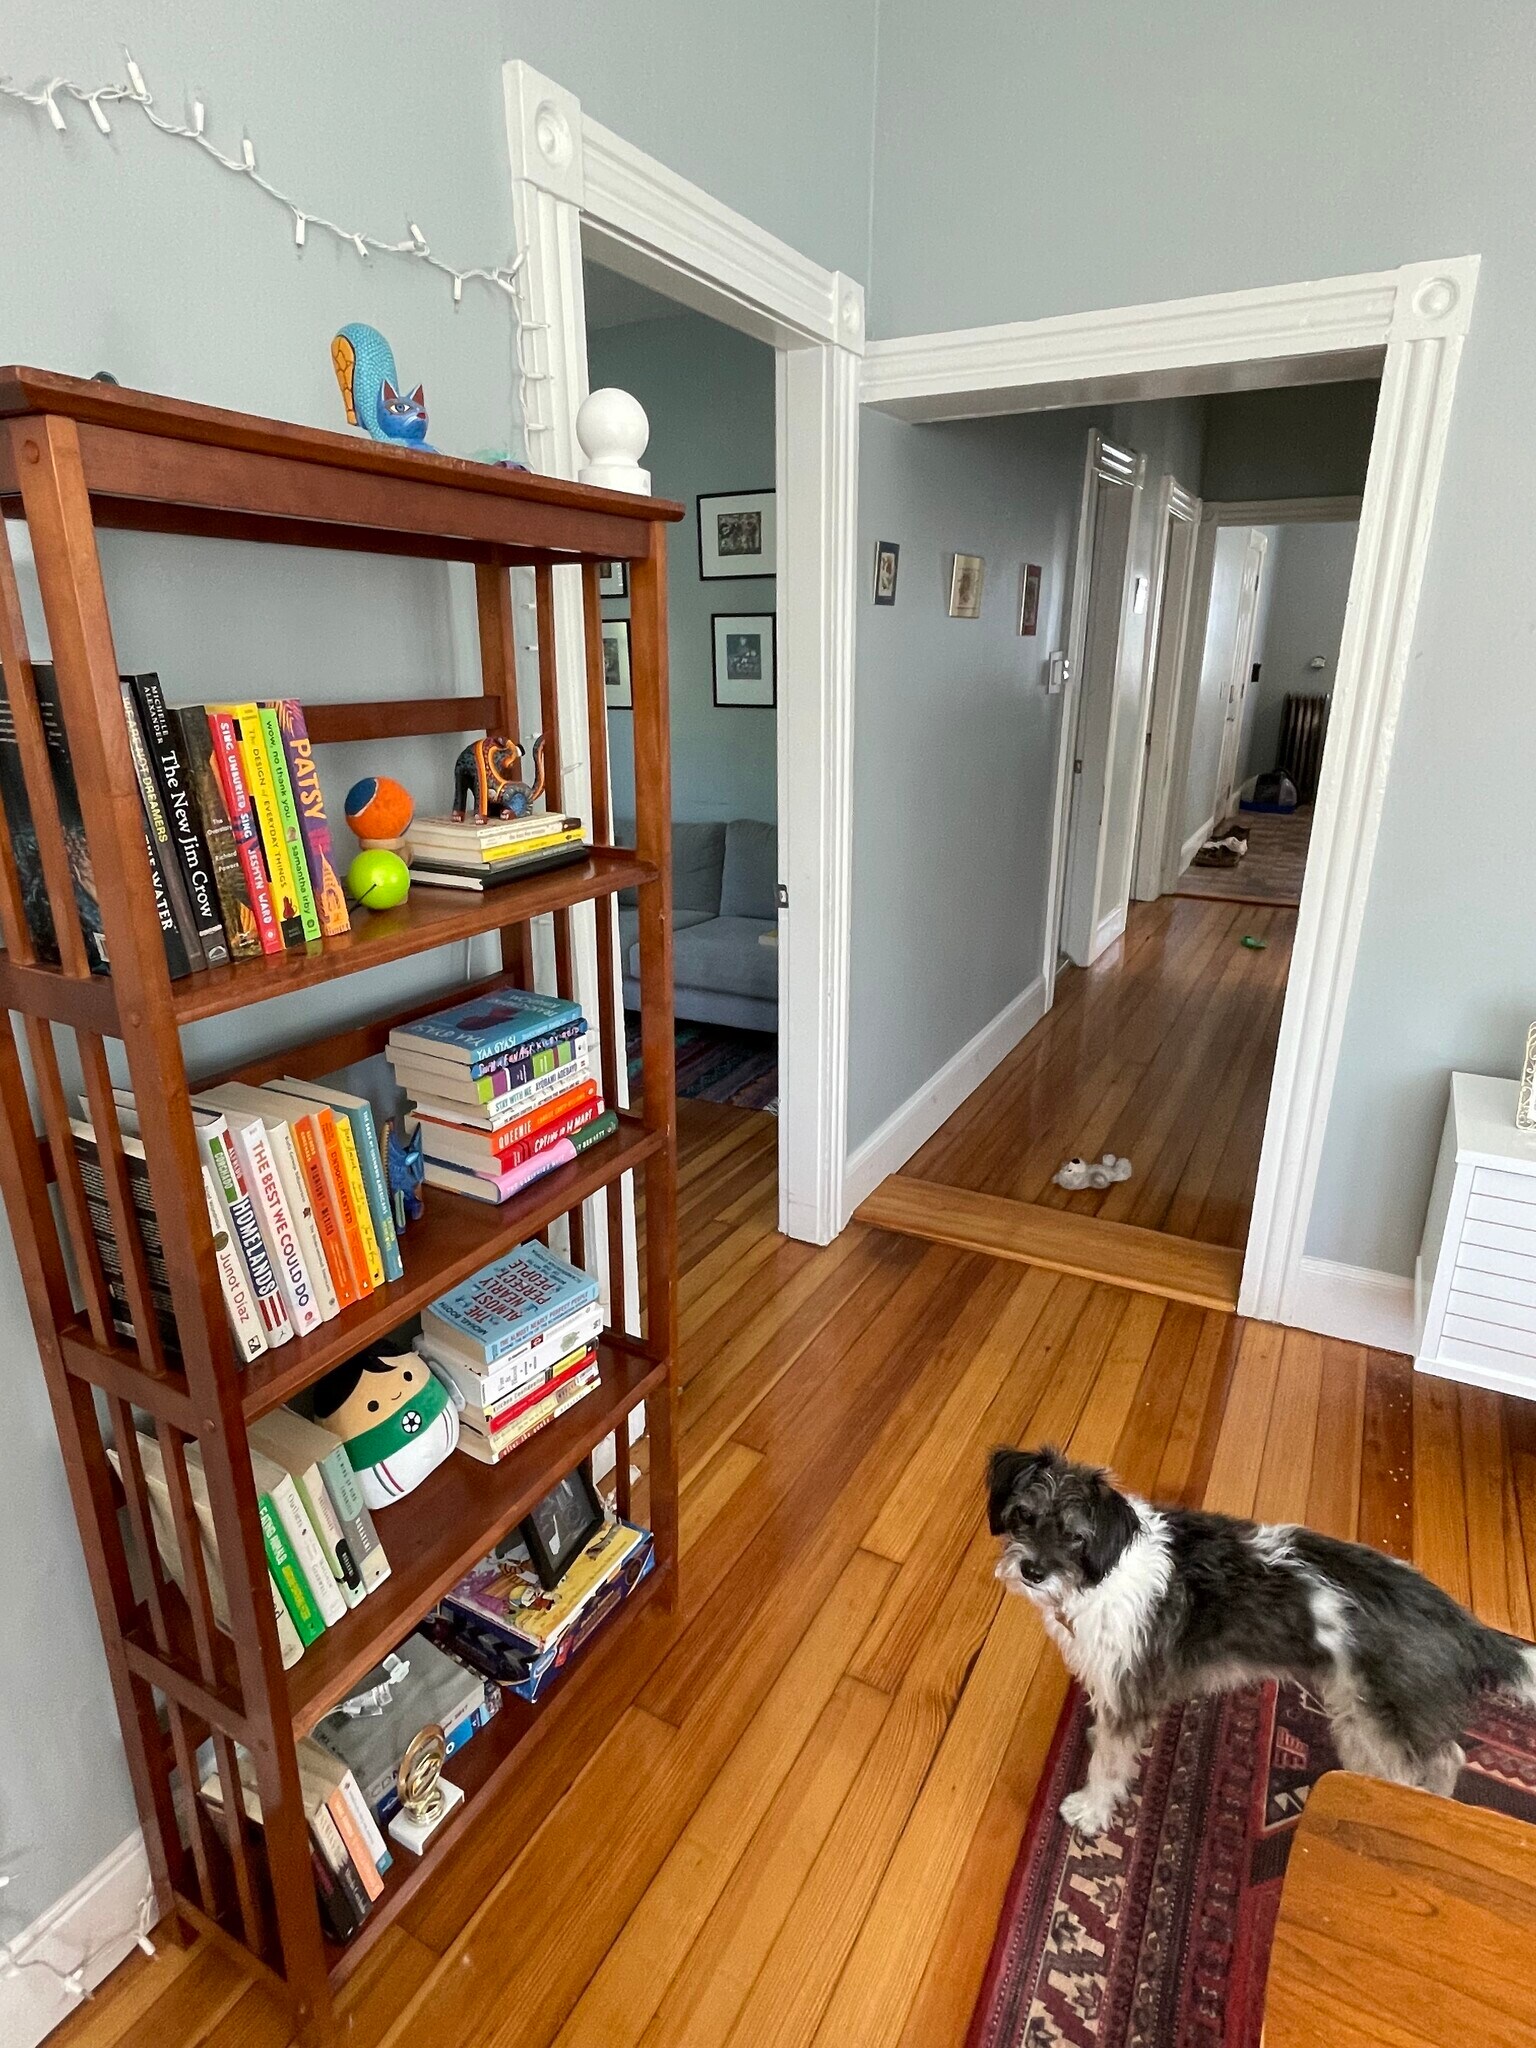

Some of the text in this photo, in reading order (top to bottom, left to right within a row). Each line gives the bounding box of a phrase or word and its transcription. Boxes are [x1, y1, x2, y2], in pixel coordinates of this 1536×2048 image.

[144, 686, 164, 744] ALEXANDER
[151, 685, 169, 736] MICHELLE
[272, 751, 280, 765] no
[275, 766, 288, 797] thank
[289, 738, 327, 819] PATSY
[142, 776, 169, 843] DREAMERS
[240, 813, 253, 839] SING
[252, 748, 267, 786] DESIGN
[263, 800, 279, 848] EVERYDAY
[274, 851, 287, 889] THINGS
[161, 750, 213, 918] The New Jim Crow
[247, 849, 273, 924] JESMYN WARD
[291, 845, 311, 914] samantha irby
[151, 870, 174, 931] WATER
[476, 1035, 517, 1061] YAA GYASI
[498, 1119, 533, 1150] QUEENIE
[573, 1108, 594, 1130] MART
[253, 1139, 271, 1174] THE
[261, 1172, 281, 1209] BEST
[331, 1151, 353, 1225] UNDOCUMENTED
[273, 1208, 288, 1234] WE
[232, 1197, 277, 1296] HOMELANDS
[280, 1233, 303, 1284] COULD
[219, 1253, 250, 1325] Junot Díaz
[479, 1277, 527, 1307] NEARLY
[496, 1270, 552, 1305] PERFECT
[508, 1259, 557, 1291] PEOPLE
[295, 1283, 310, 1307] DO
[439, 1301, 462, 1319] BOOTH
[471, 1292, 523, 1322] ALMOST
[464, 1305, 492, 1324] THE
